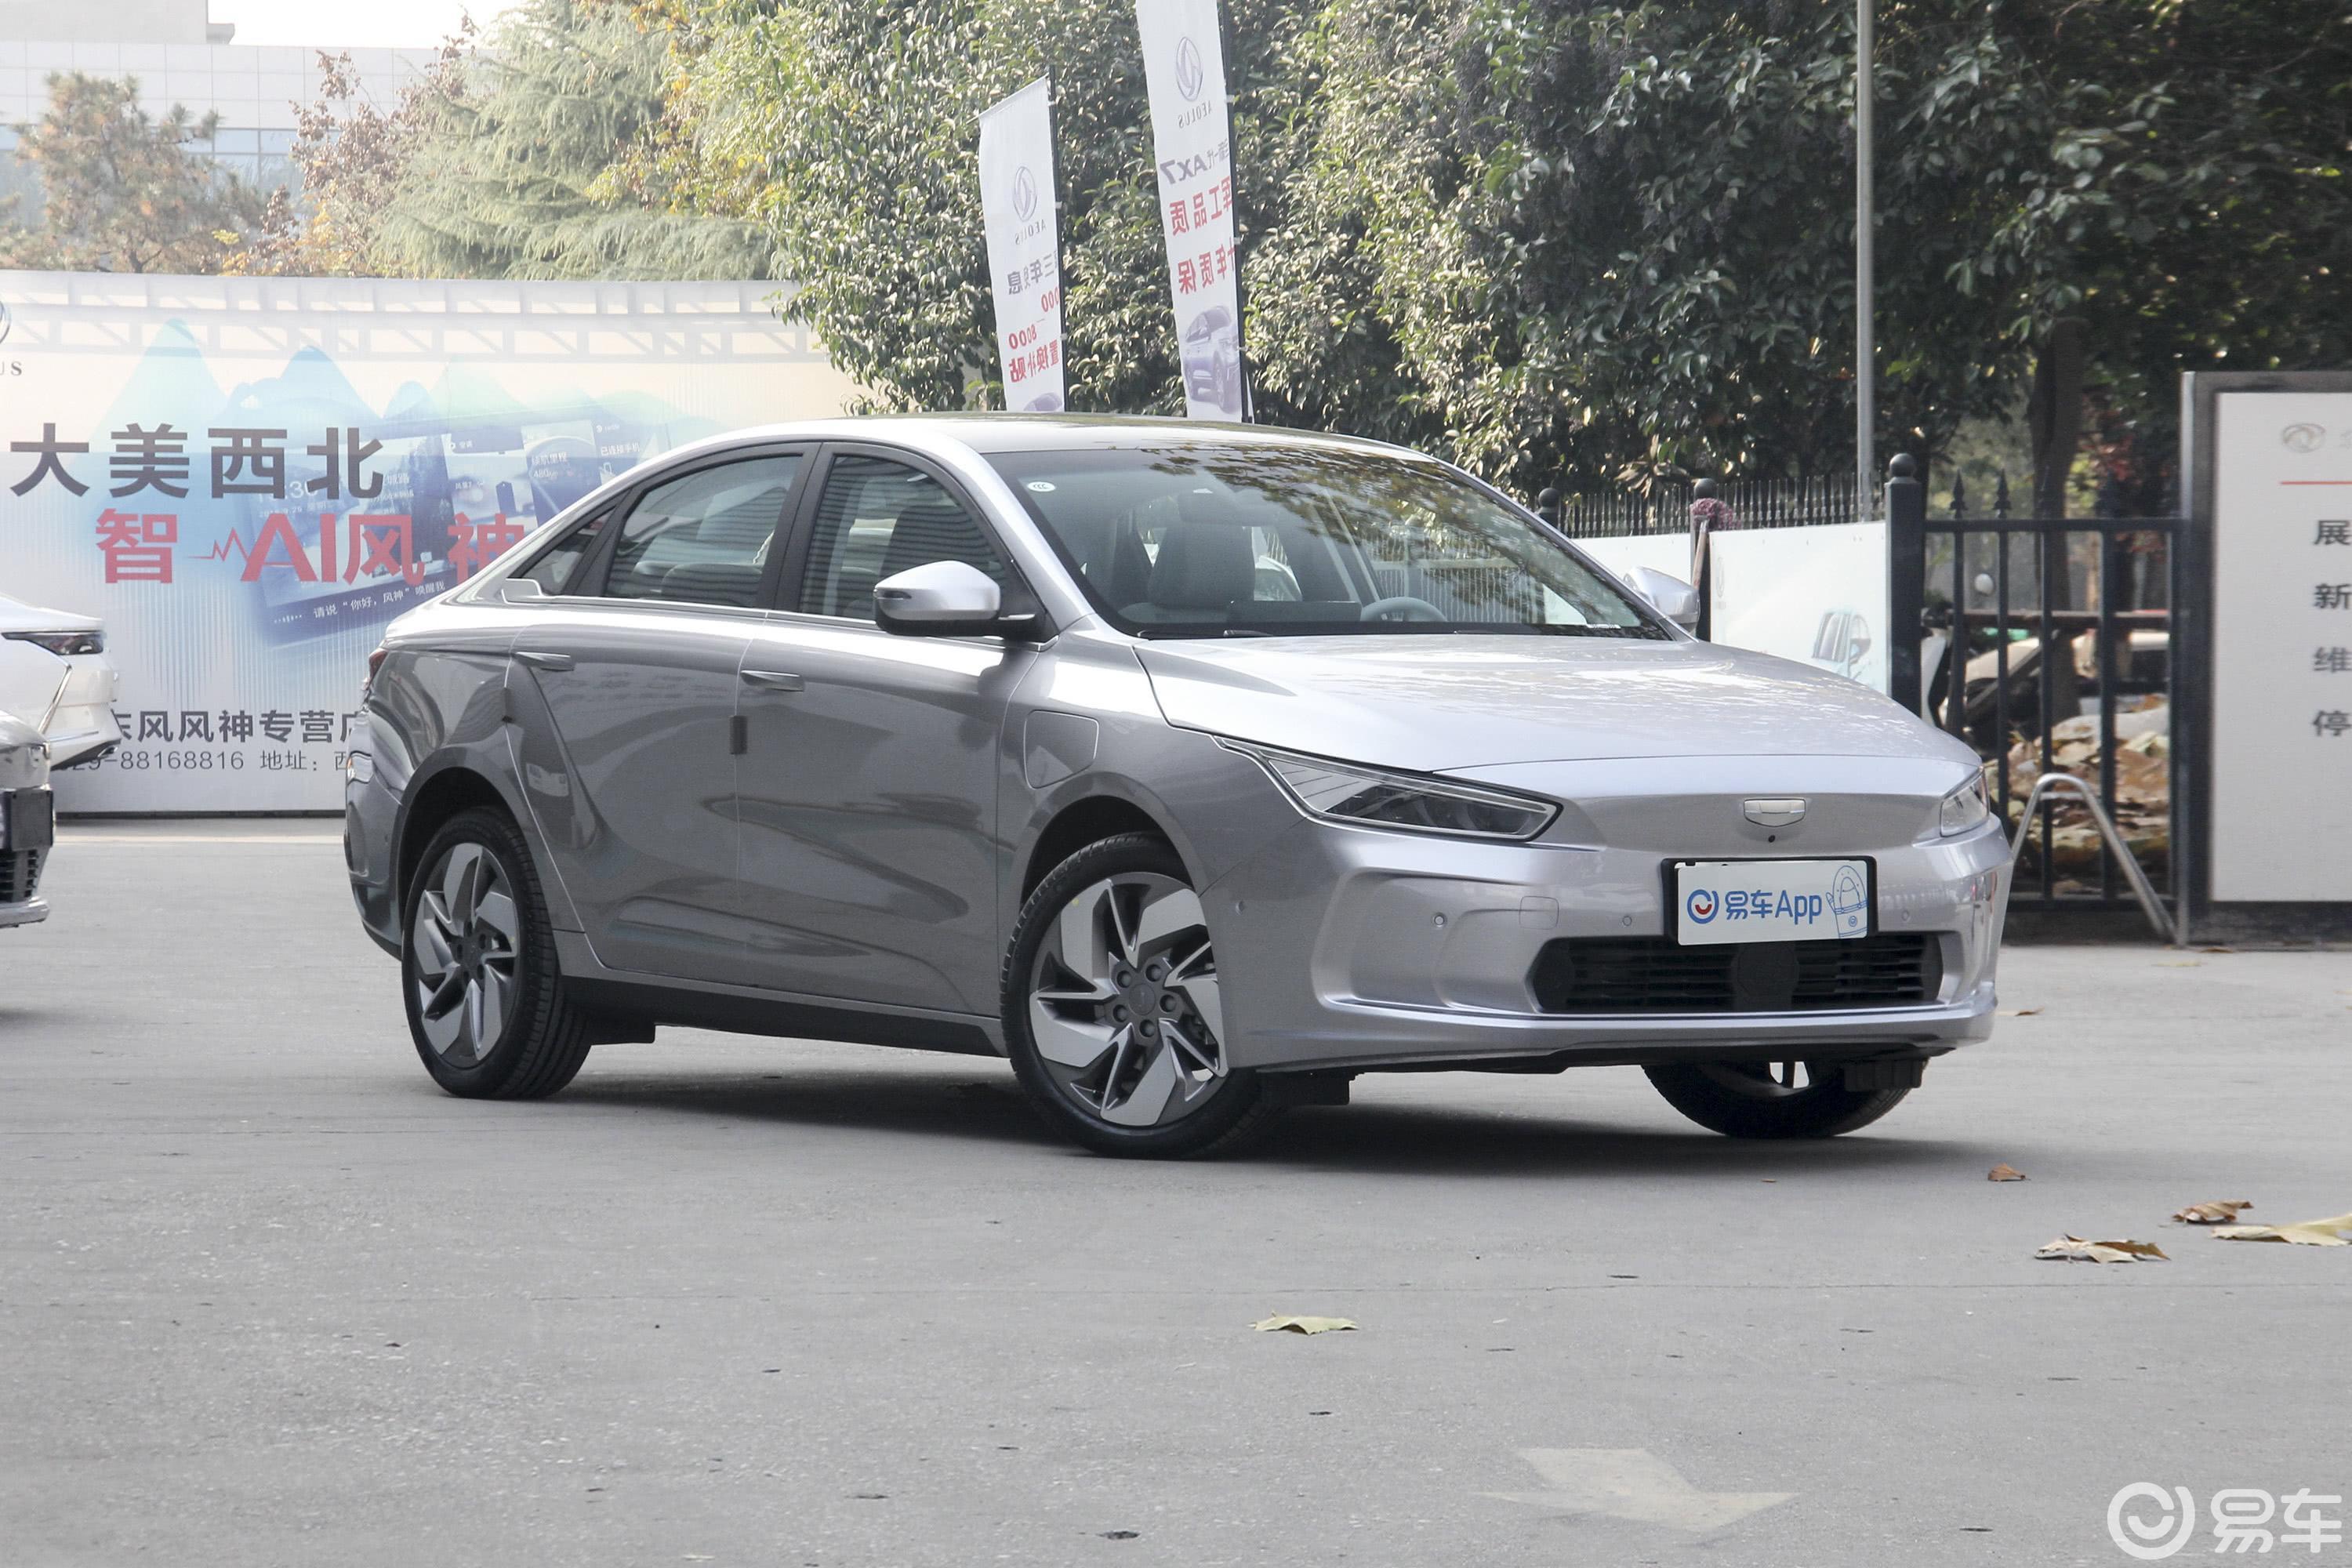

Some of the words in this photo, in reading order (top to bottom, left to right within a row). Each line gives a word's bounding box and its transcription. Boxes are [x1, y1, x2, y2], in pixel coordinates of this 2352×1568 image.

[9, 422, 383, 499] 大美西北
[1725, 890, 1822, 925] 易车App
